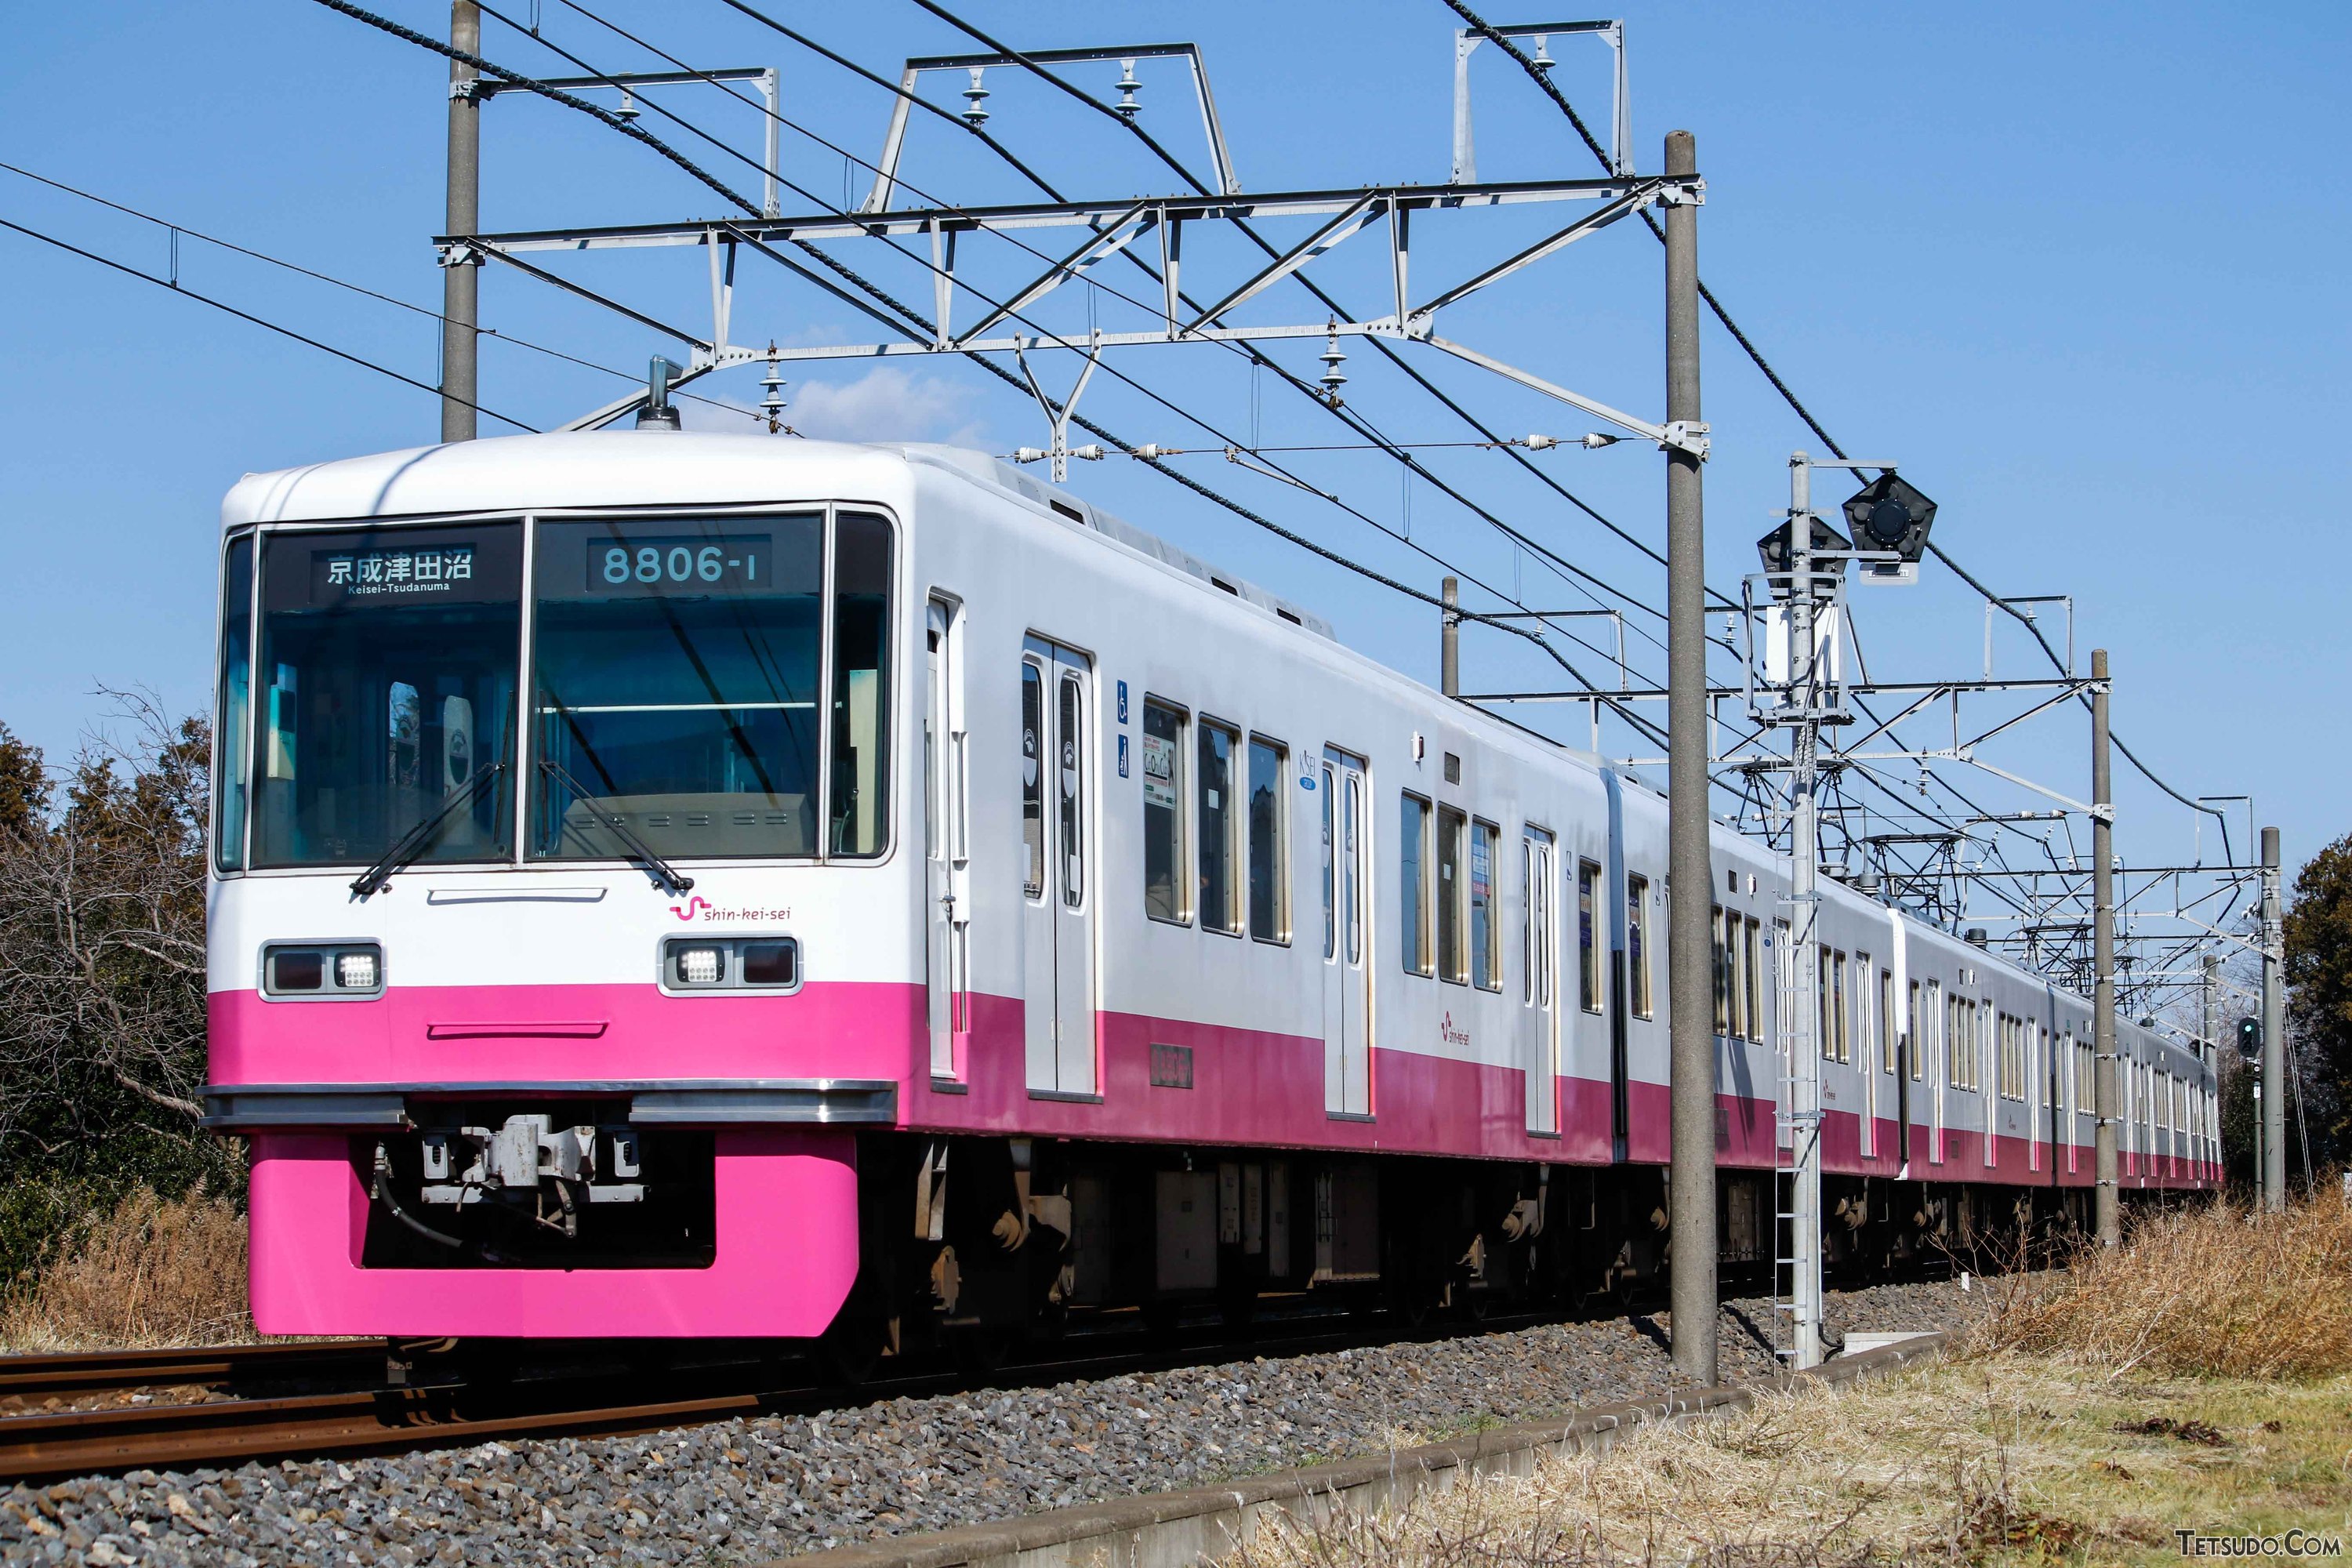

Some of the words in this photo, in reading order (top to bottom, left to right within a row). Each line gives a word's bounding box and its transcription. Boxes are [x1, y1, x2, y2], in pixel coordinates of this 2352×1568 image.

[328, 549, 471, 584] 京成津田沼
[604, 546, 755, 583] 8806-1
[348, 583, 450, 594] Keisei-Tsudanuma
[705, 906, 791, 921] shin-kei-sei
